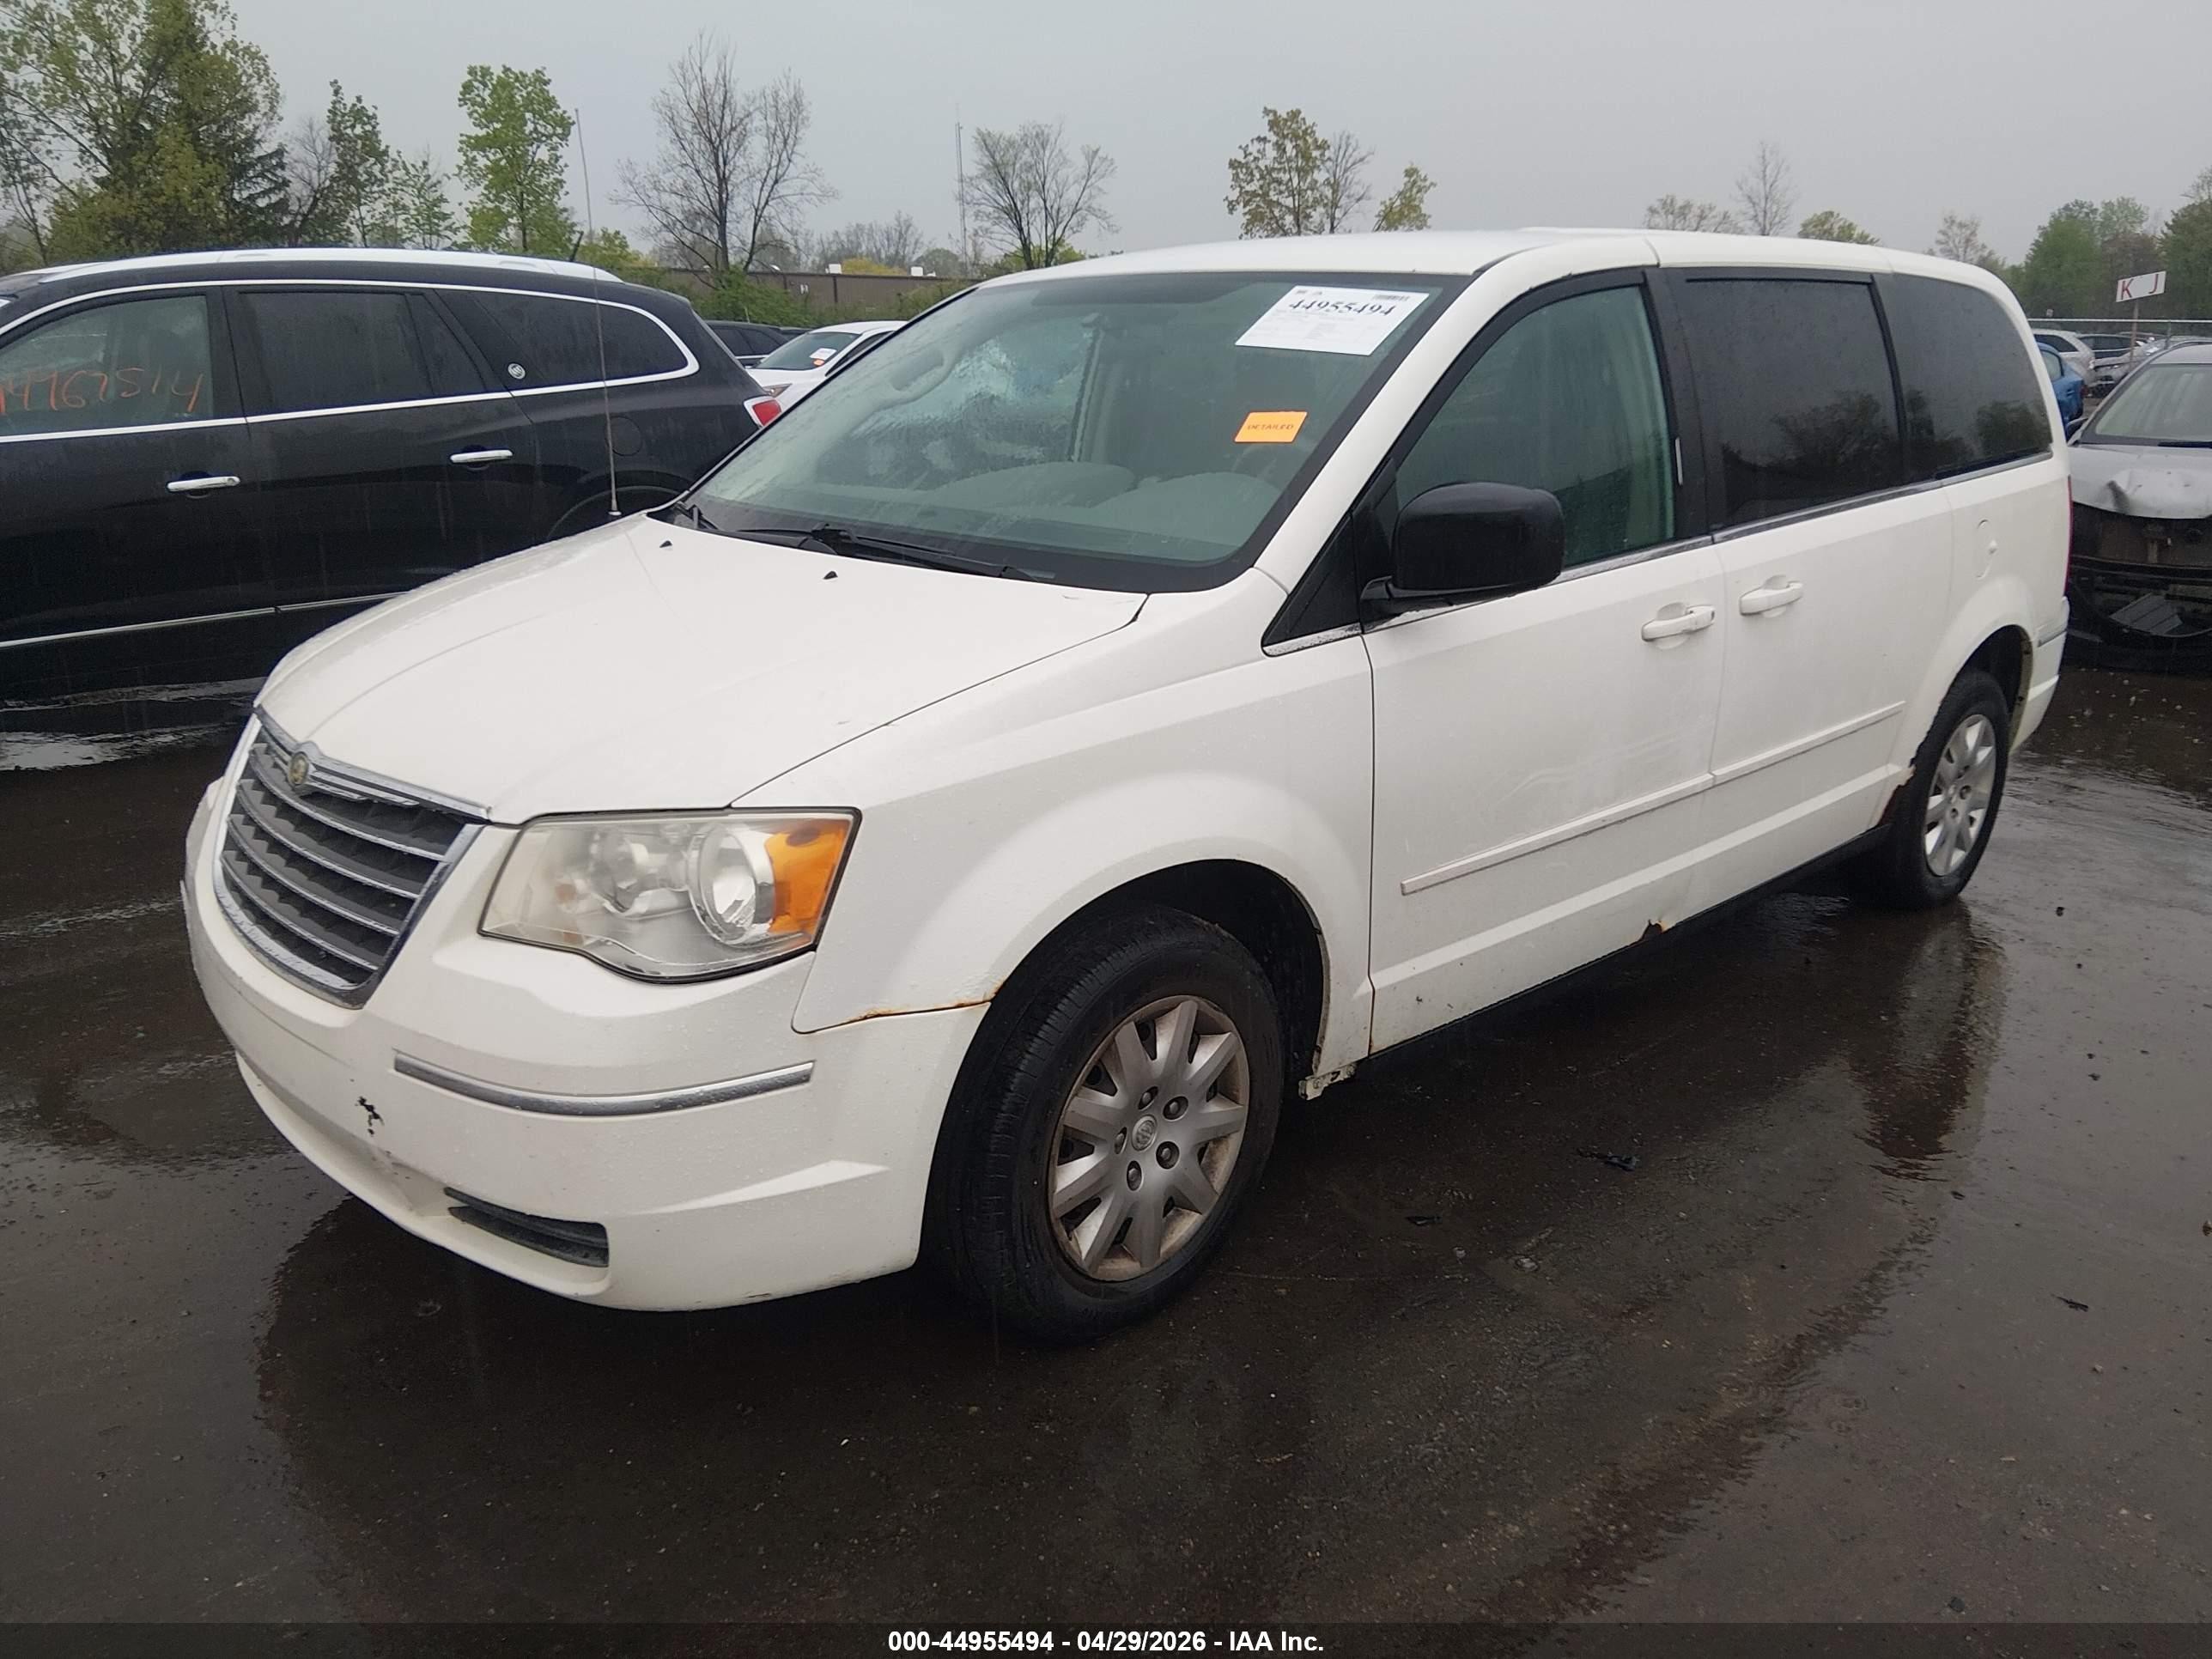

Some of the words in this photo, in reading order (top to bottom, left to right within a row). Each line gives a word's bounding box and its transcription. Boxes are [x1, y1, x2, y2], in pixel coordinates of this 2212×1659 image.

[2121, 278, 2134, 300] K
[2148, 273, 2159, 294] J
[1289, 299, 1397, 316] 44955494
